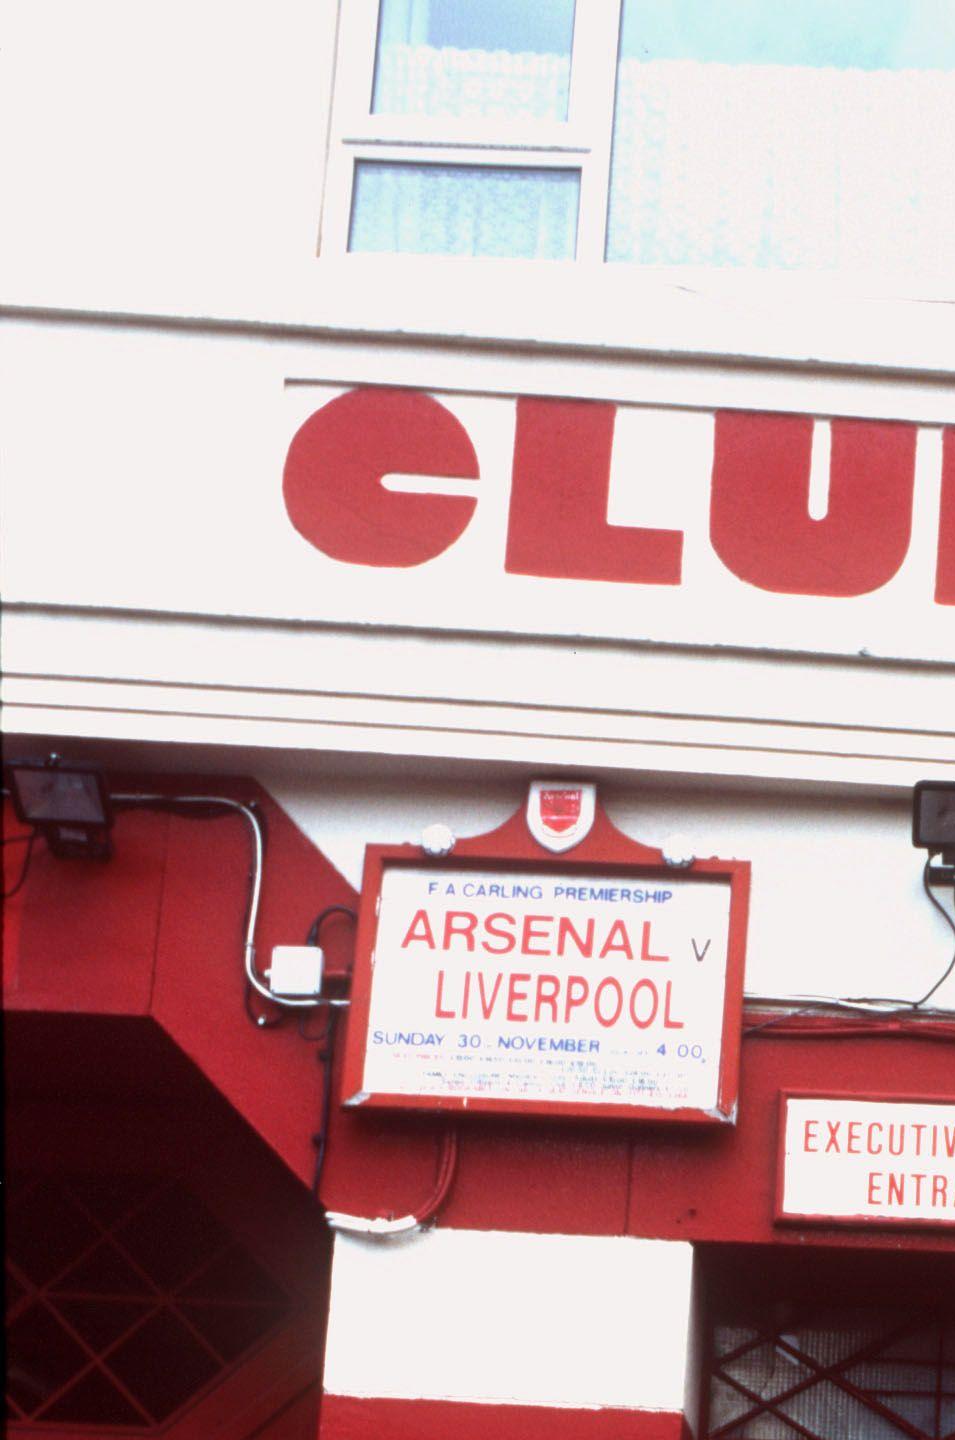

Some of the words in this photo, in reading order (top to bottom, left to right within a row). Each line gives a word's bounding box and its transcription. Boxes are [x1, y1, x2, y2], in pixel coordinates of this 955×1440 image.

[428, 882, 438, 895] F
[445, 883, 456, 895] A
[463, 883, 543, 899] CARLING
[554, 886, 673, 904] PREMIERSHIP
[401, 909, 670, 962] ARSENAL
[435, 970, 684, 1029] LIVERPOOL
[373, 1031, 445, 1046] SUNDAY
[458, 1034, 482, 1048] 30
[498, 1036, 600, 1053] NOVEMBER
